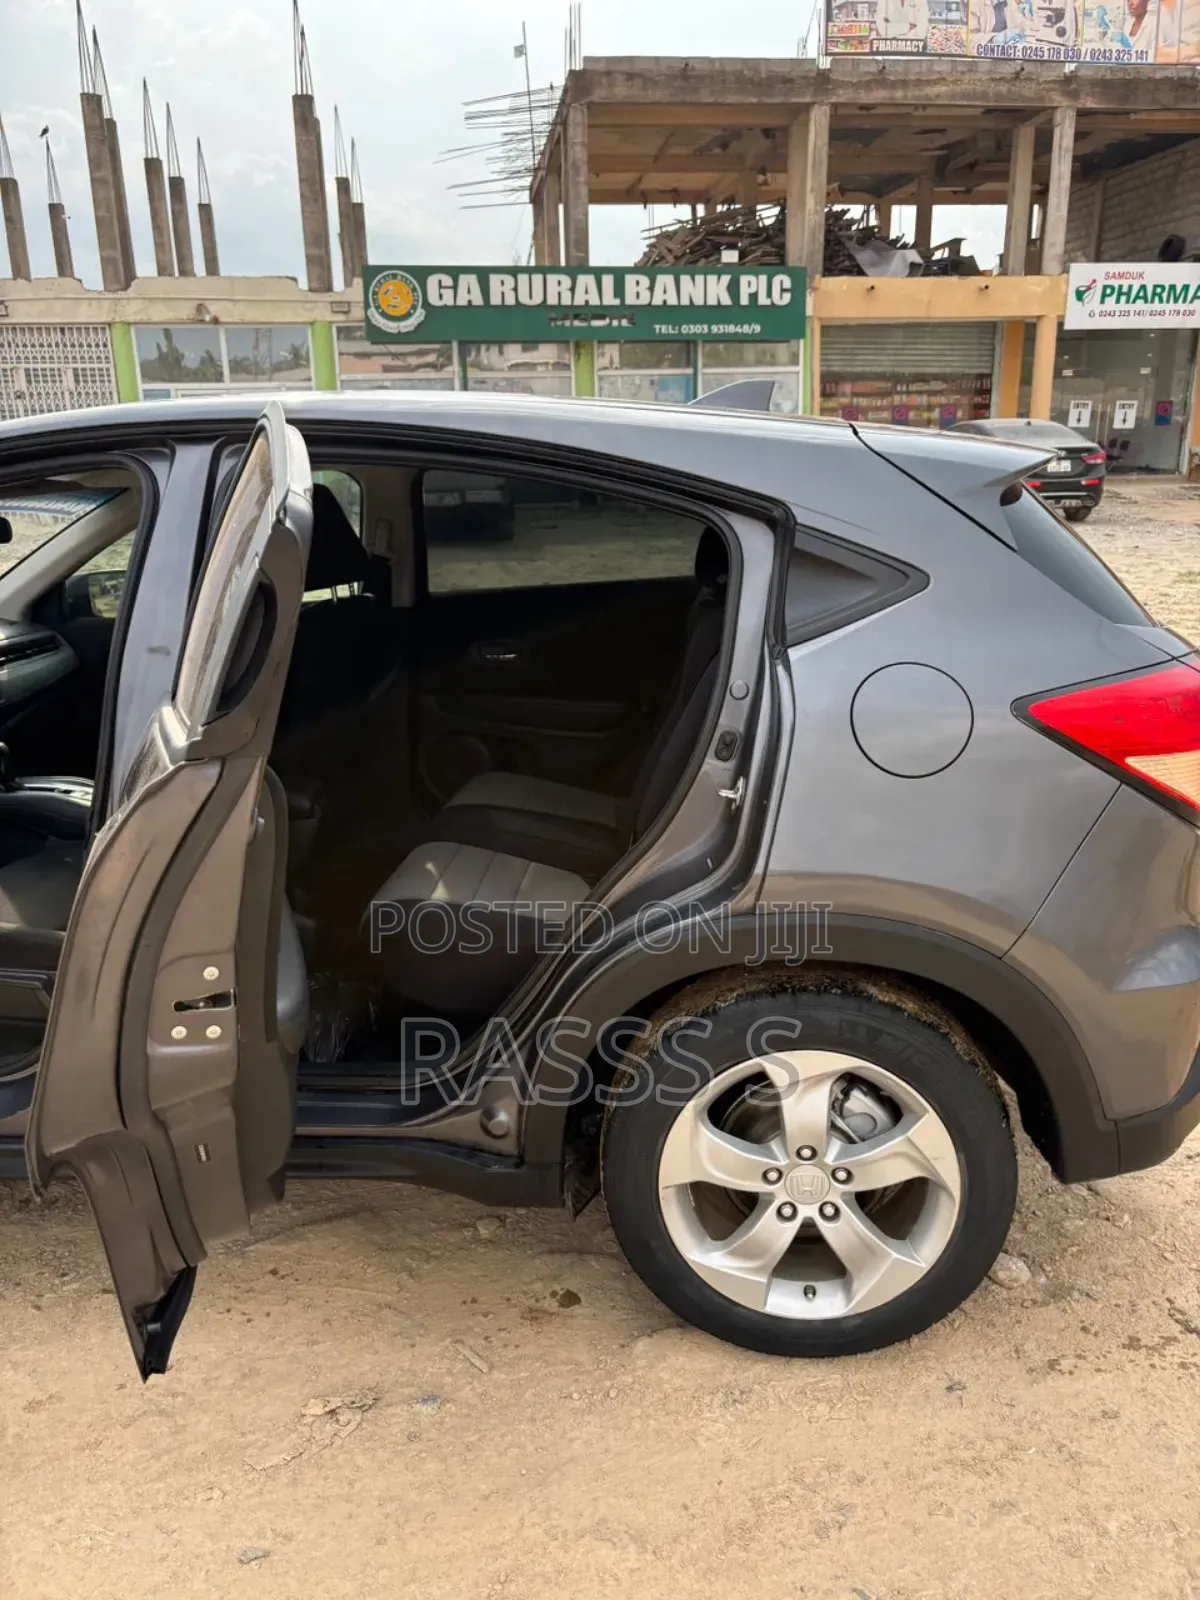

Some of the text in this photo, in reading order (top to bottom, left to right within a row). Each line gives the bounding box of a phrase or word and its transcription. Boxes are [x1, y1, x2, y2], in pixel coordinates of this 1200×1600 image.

[873, 39, 925, 52] PHARMACY
[976, 43, 1020, 57] CONTACT:
[1021, 45, 1044, 58] 0245
[1047, 46, 1061, 59] 178
[1063, 48, 1081, 60] 030
[1090, 48, 1113, 61] 0243
[1114, 49, 1132, 61] 325
[1134, 50, 1148, 62] 141
[1104, 271, 1144, 281] SAMDUK
[426, 273, 484, 307] GA
[489, 273, 620, 306] RURAL
[624, 273, 733, 306] BANK
[739, 273, 792, 306] PLC
[1098, 309, 1116, 317] 0243
[1117, 309, 1131, 317] 325
[1168, 309, 1181, 317] 178
[1182, 309, 1196, 317] 030
[653, 324, 761, 335] TEL: 0303 931848/9
